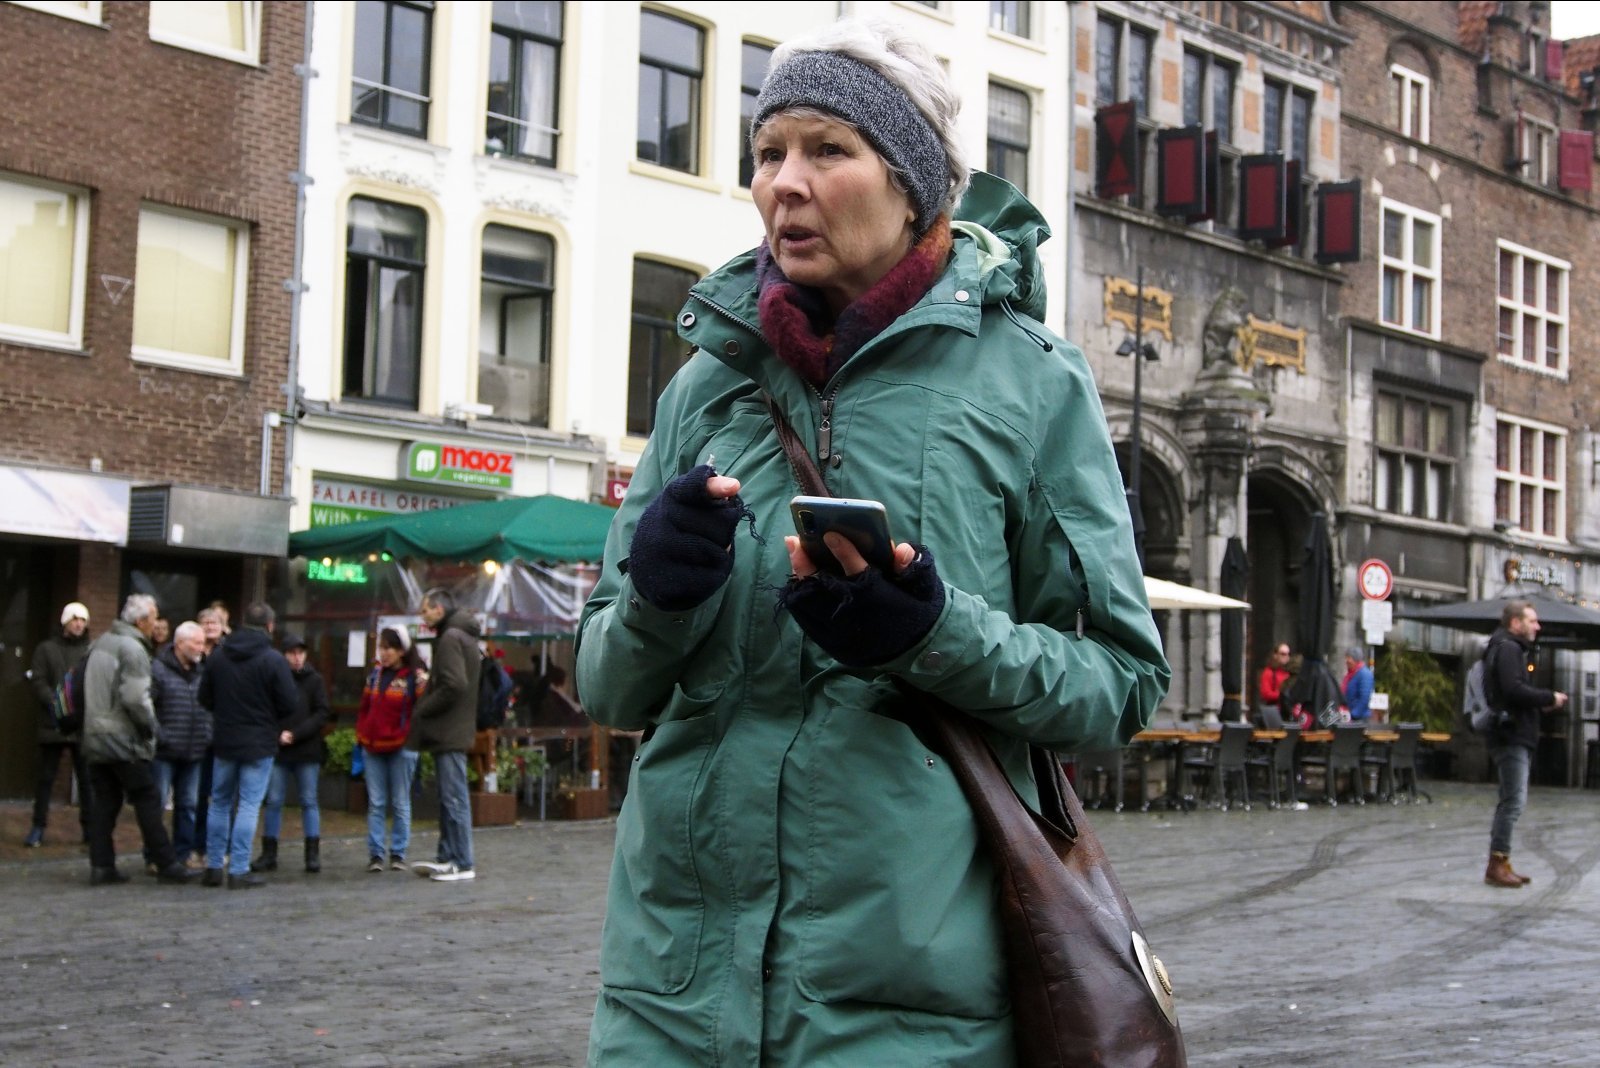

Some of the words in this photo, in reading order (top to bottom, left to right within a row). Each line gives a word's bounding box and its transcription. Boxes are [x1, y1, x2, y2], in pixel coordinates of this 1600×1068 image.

[441, 445, 513, 474] maoz
[313, 484, 387, 508] FALAFEL
[313, 507, 350, 526] With
